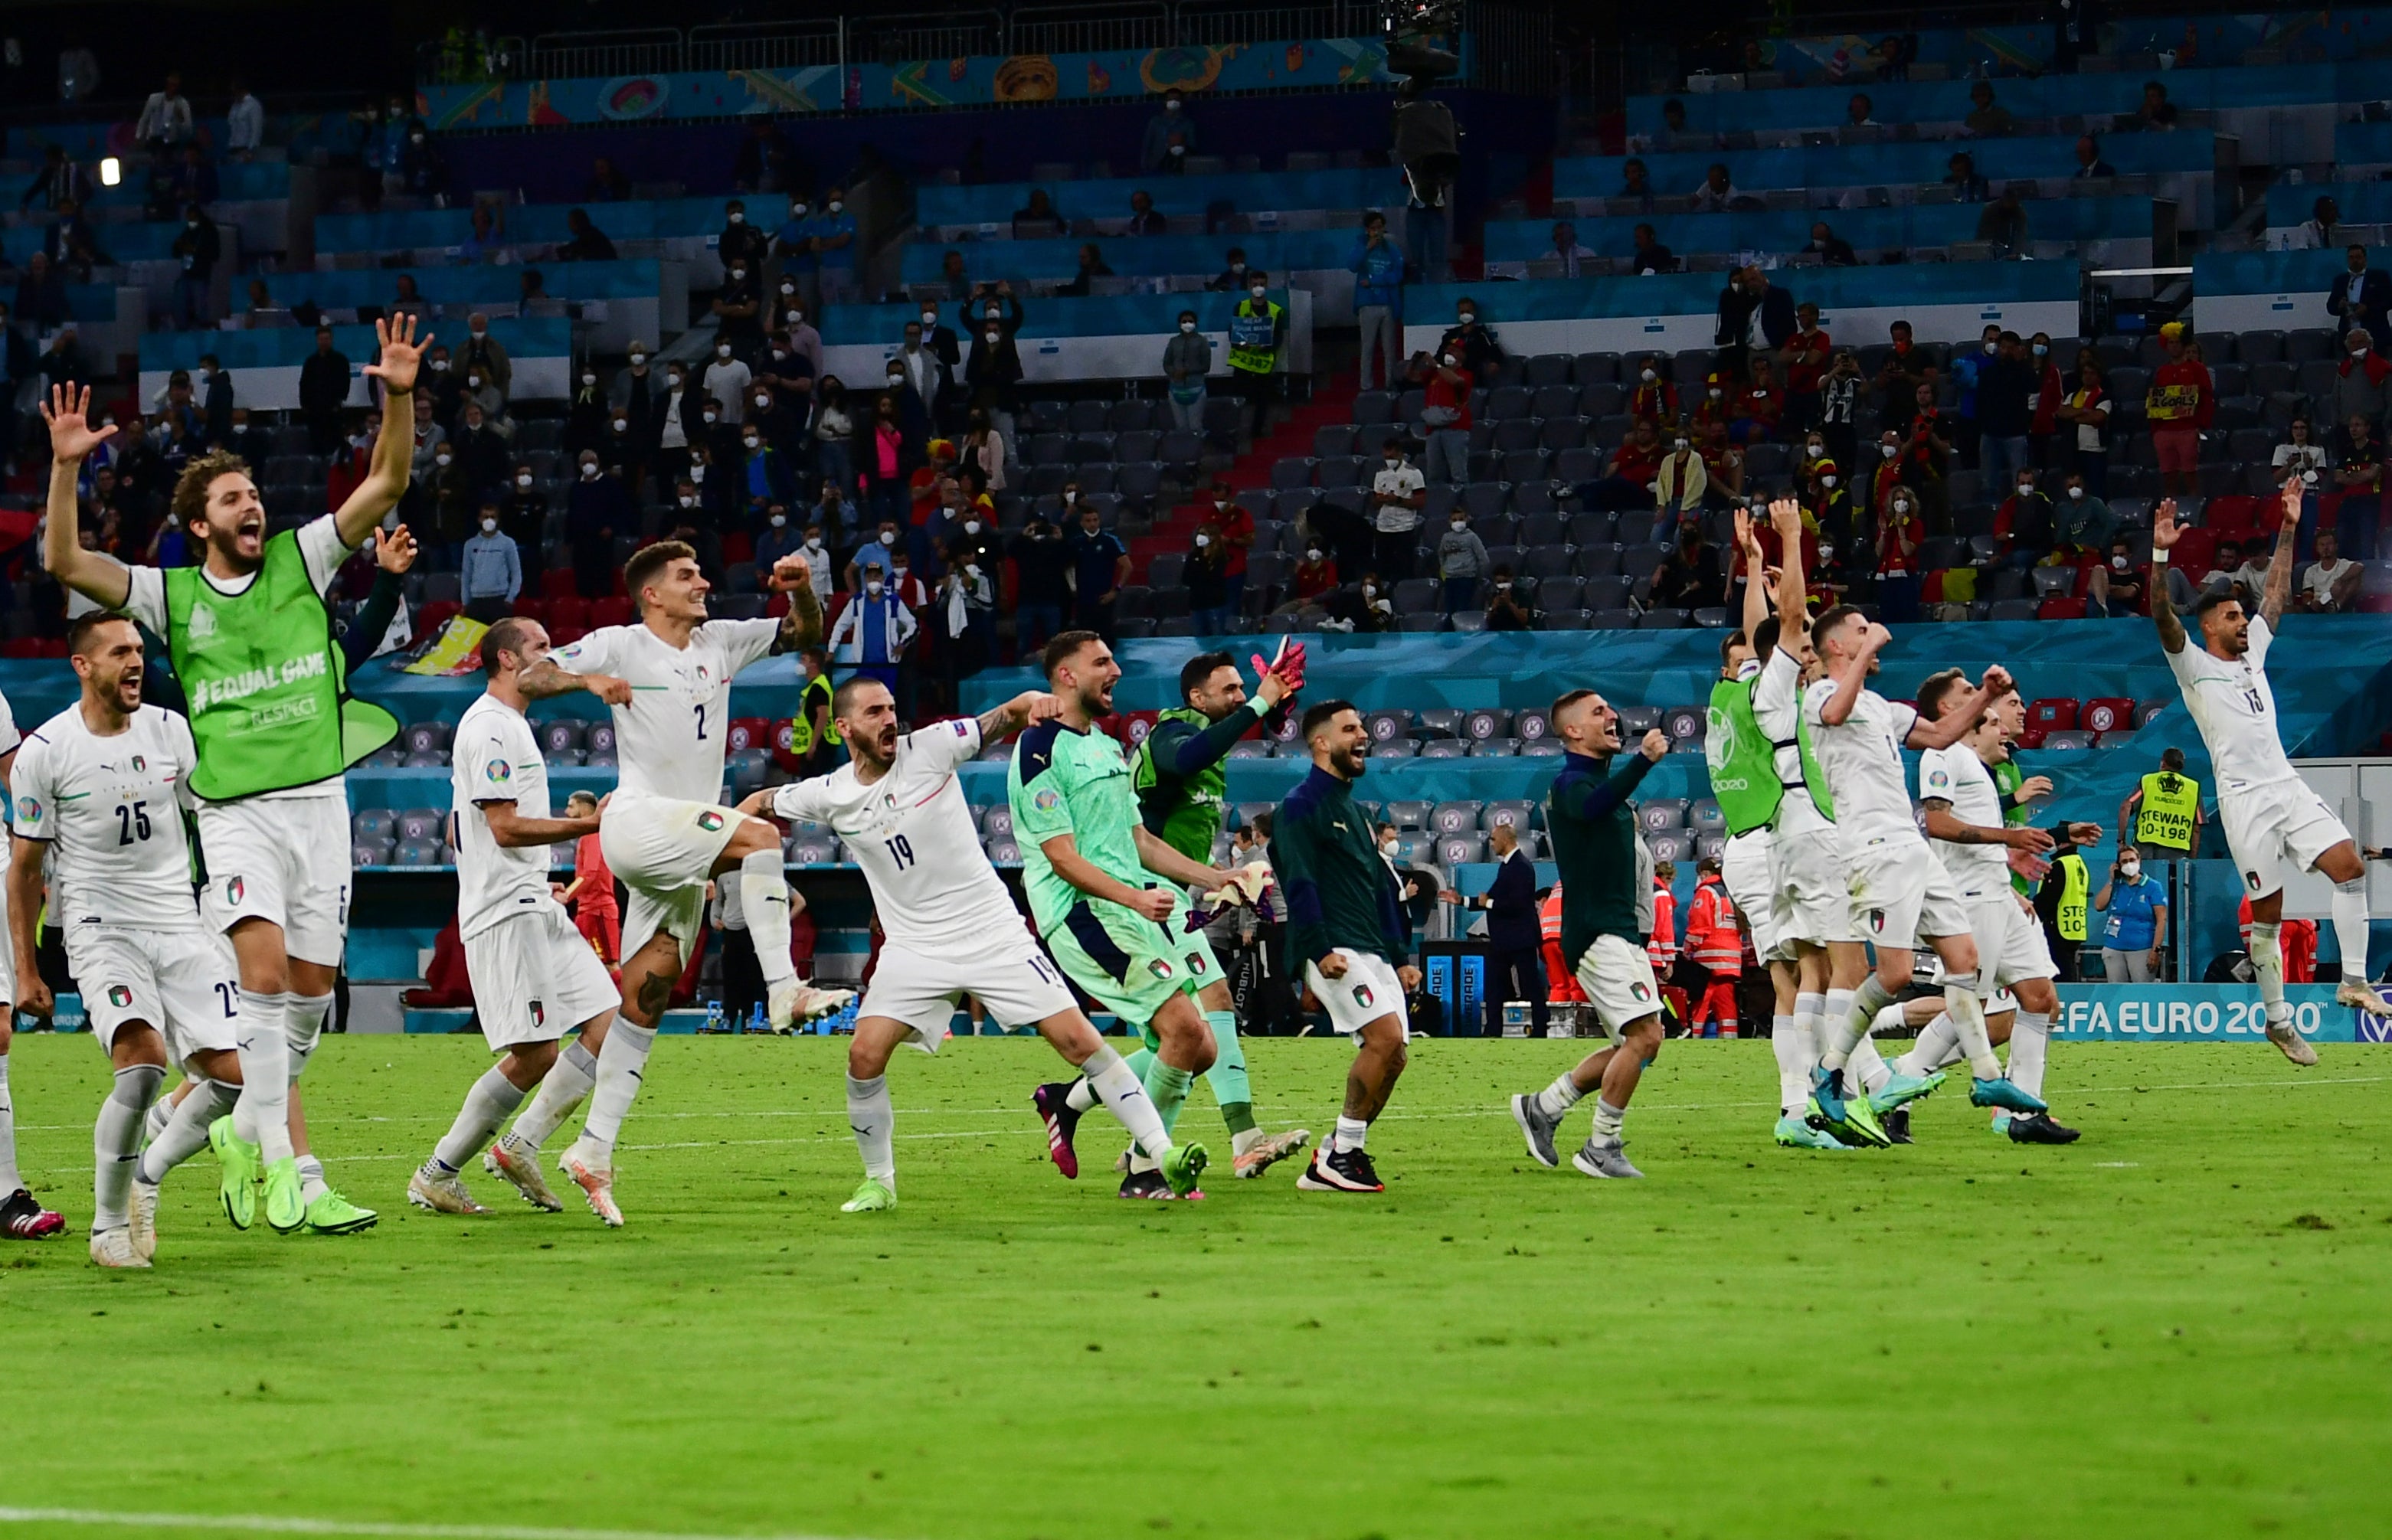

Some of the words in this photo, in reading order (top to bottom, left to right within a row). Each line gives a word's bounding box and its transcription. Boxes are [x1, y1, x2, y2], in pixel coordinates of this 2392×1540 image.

[2161, 395, 2195, 407] GOALS
[192, 665, 280, 714] #EQUAL
[281, 651, 326, 685] GAME
[251, 698, 317, 727] RESPECT
[2243, 688, 2264, 714] 13
[694, 704, 707, 740] 2
[116, 800, 151, 846] 25
[885, 835, 915, 871] 19
[2063, 905, 2086, 917] STE
[1027, 955, 1057, 985] 19
[1235, 962, 1250, 1009] HUBLOT
[2052, 1002, 2112, 1033] EFA
[2119, 1002, 2220, 1034] EURO
